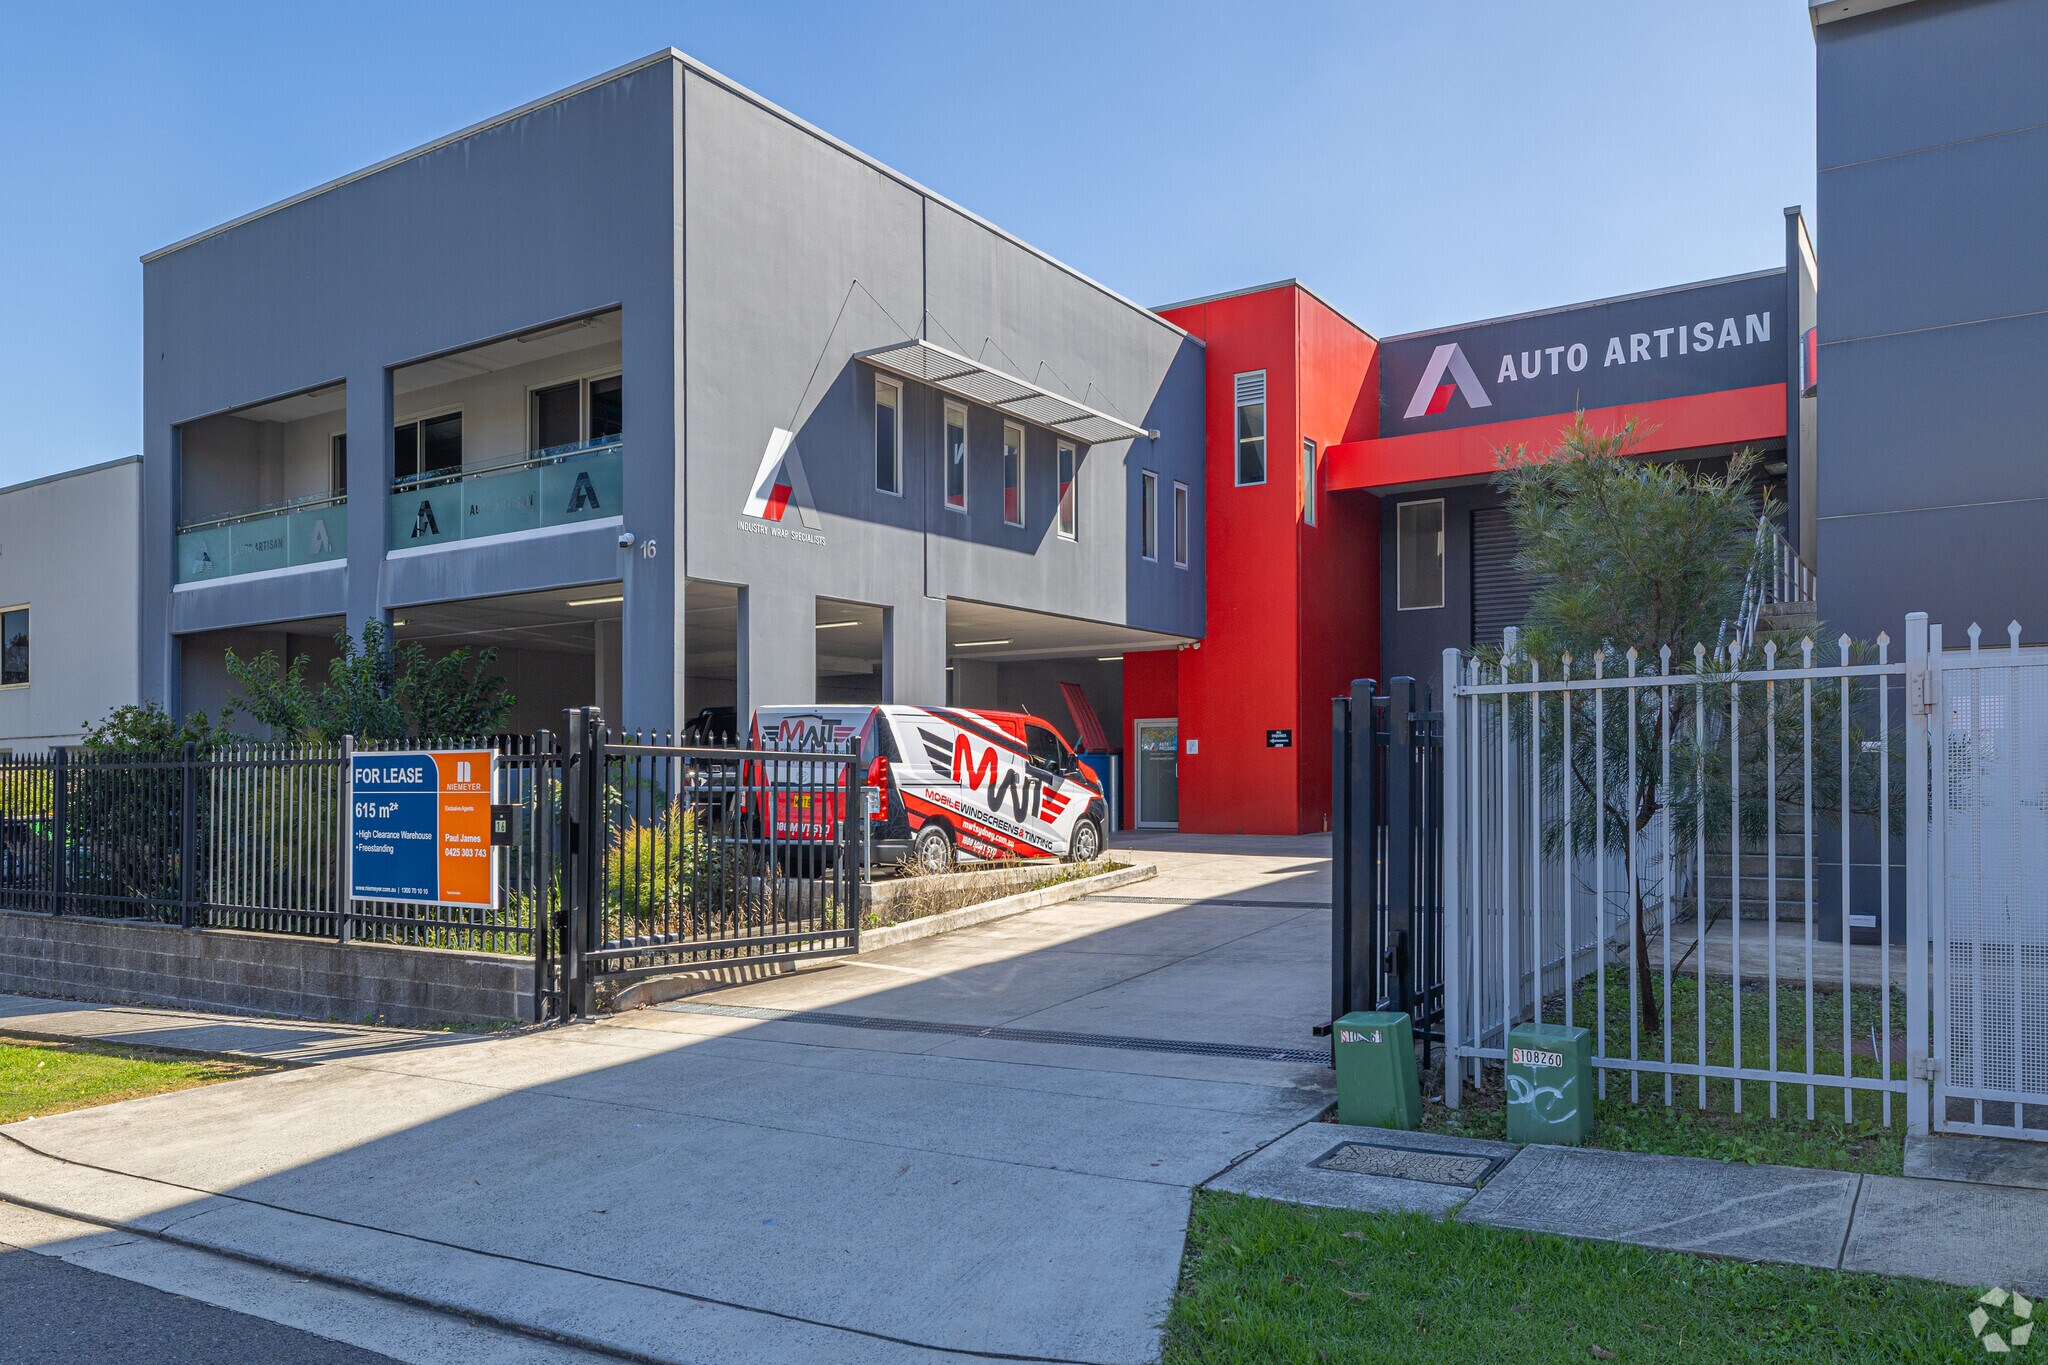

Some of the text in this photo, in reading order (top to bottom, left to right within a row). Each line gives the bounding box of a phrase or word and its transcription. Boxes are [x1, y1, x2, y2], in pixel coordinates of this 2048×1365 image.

[1497, 311, 1770, 383] AUTO ARTISAN
[737, 520, 826, 546] INDUSTRY WRAP SPECIALISTS
[640, 540, 657, 559] 16
[355, 767, 423, 784] FOR LEASE
[446, 783, 481, 791] NIEMEYER
[355, 802, 376, 818] 615
[496, 821, 505, 832] 16
[358, 830, 432, 840] High Clearance Warehouse
[445, 833, 481, 843] Paul James
[358, 844, 394, 855] Freestanding
[445, 848, 487, 858] 0425 303 743
[1513, 1047, 1562, 1067] S108260
